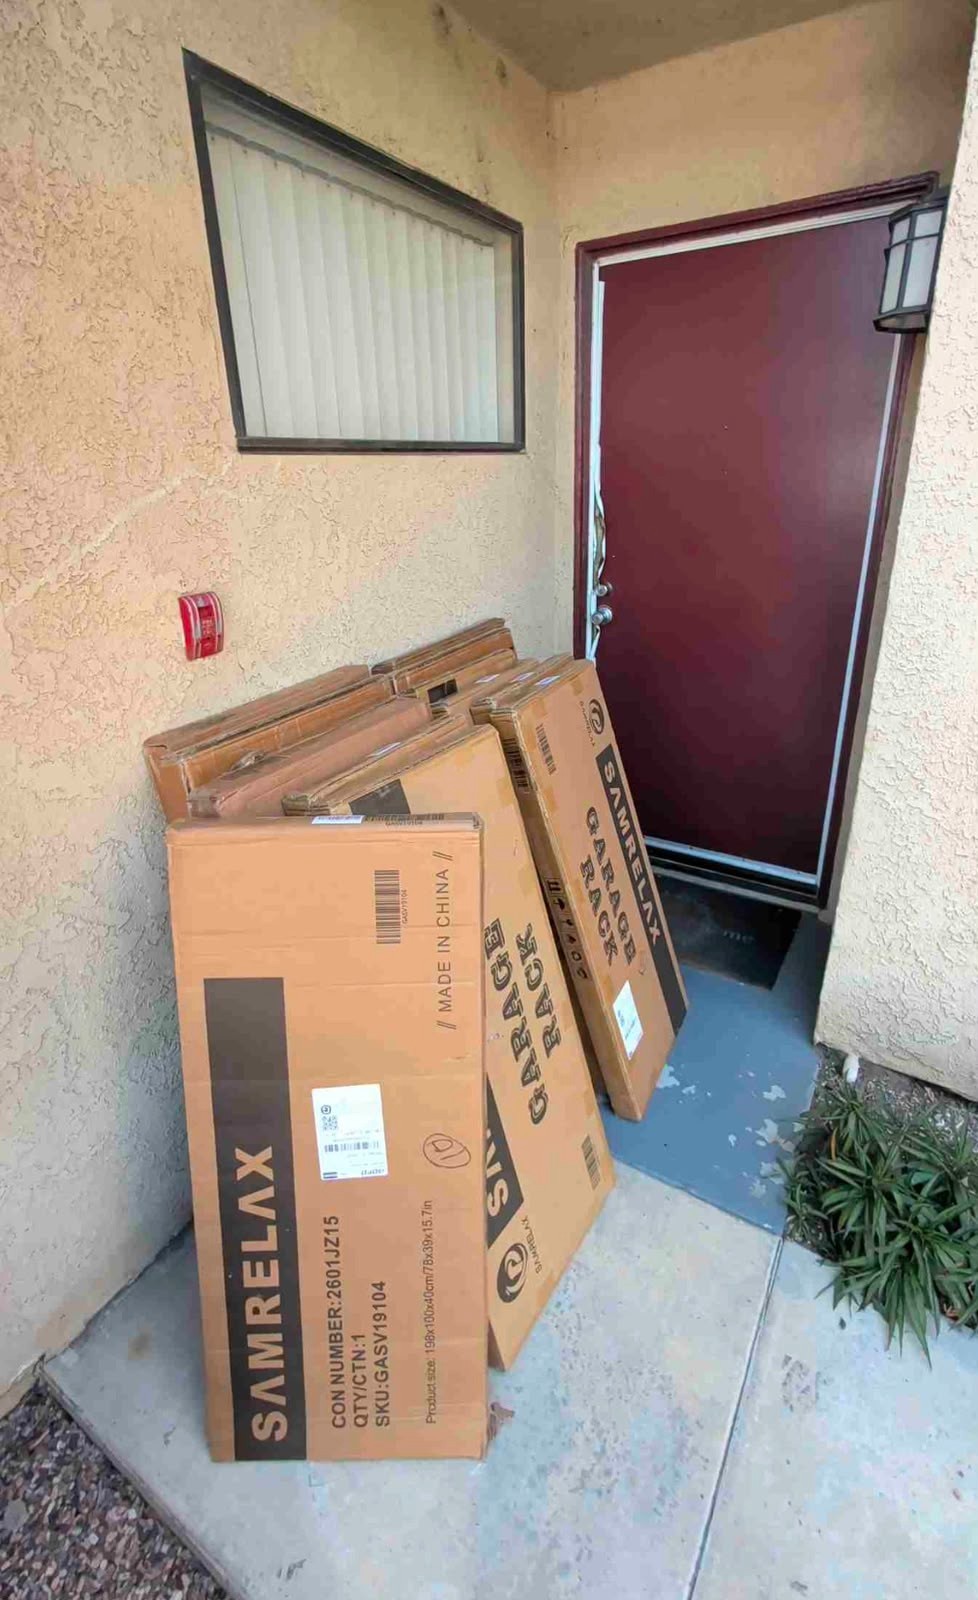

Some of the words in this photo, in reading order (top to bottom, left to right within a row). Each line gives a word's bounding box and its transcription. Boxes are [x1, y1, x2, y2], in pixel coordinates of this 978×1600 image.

[435, 868, 450, 928] CHINA
[579, 853, 618, 968] RACK
[586, 806, 637, 967] GARAGE
[603, 760, 661, 947] SAMRELAX
[437, 936, 451, 953] IN
[437, 961, 452, 1013] MADE
[516, 922, 562, 1059] RACK
[484, 917, 548, 1125] GARAGE
[234, 1145, 290, 1443] SAMRELAX
[322, 1215, 346, 1387] NUMBER:2601JZ15
[371, 1281, 391, 1428] SKU:GASV19104
[331, 1390, 347, 1429] CON
[351, 1333, 369, 1429] QTY/CTN:1
[425, 1382, 438, 1424] Product
